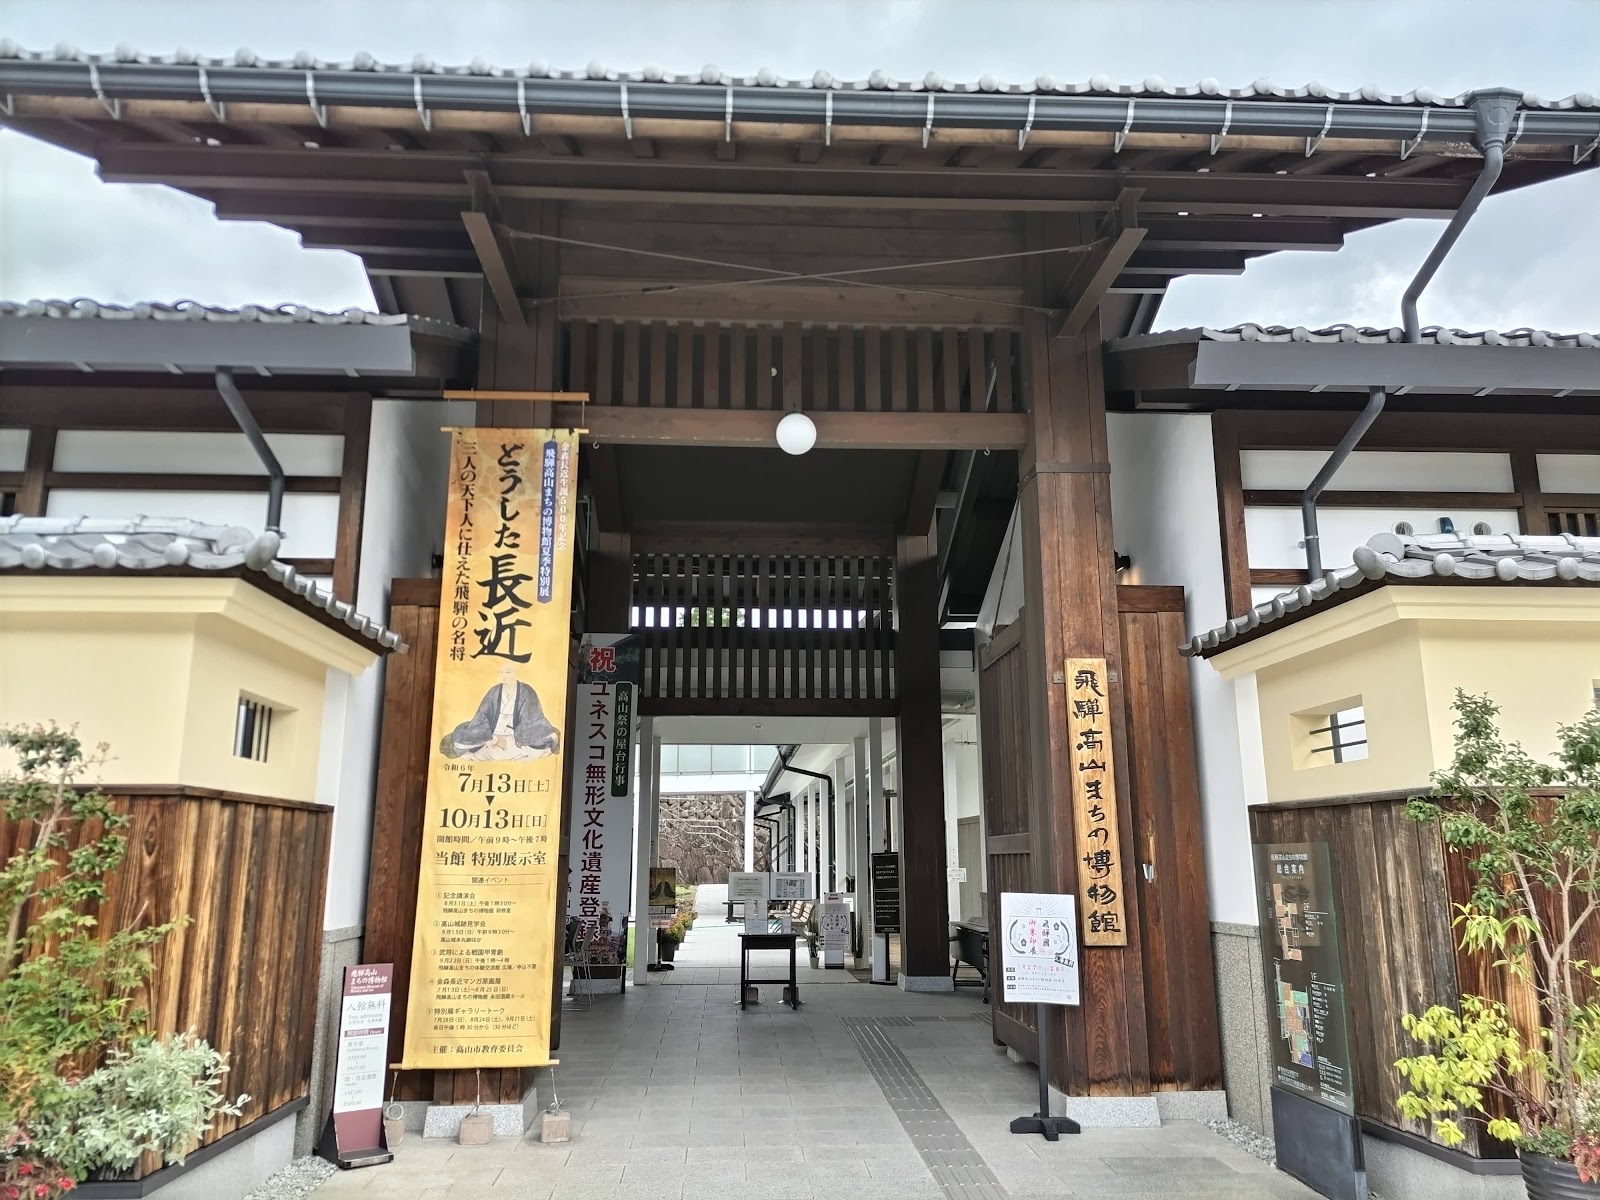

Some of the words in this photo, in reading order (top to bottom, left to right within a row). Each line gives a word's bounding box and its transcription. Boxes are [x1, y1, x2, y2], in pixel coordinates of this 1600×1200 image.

[450, 441, 477, 662] 三人の天下人に仕えた飛騨の名将
[470, 443, 533, 664] どうした長近
[539, 448, 556, 597] 飛騨高山まちの博物館夏季特別展
[590, 646, 617, 673] 祝
[443, 763, 475, 772] 令和6年
[614, 690, 629, 787] 高山祭の屋台行事
[577, 681, 610, 943] ユネスコ無形文化遺産登録
[435, 851, 465, 866] 当館
[471, 851, 547, 866] 特別展示室
[471, 876, 509, 884] 関連イベント
[346, 999, 387, 1011] 入館無料
